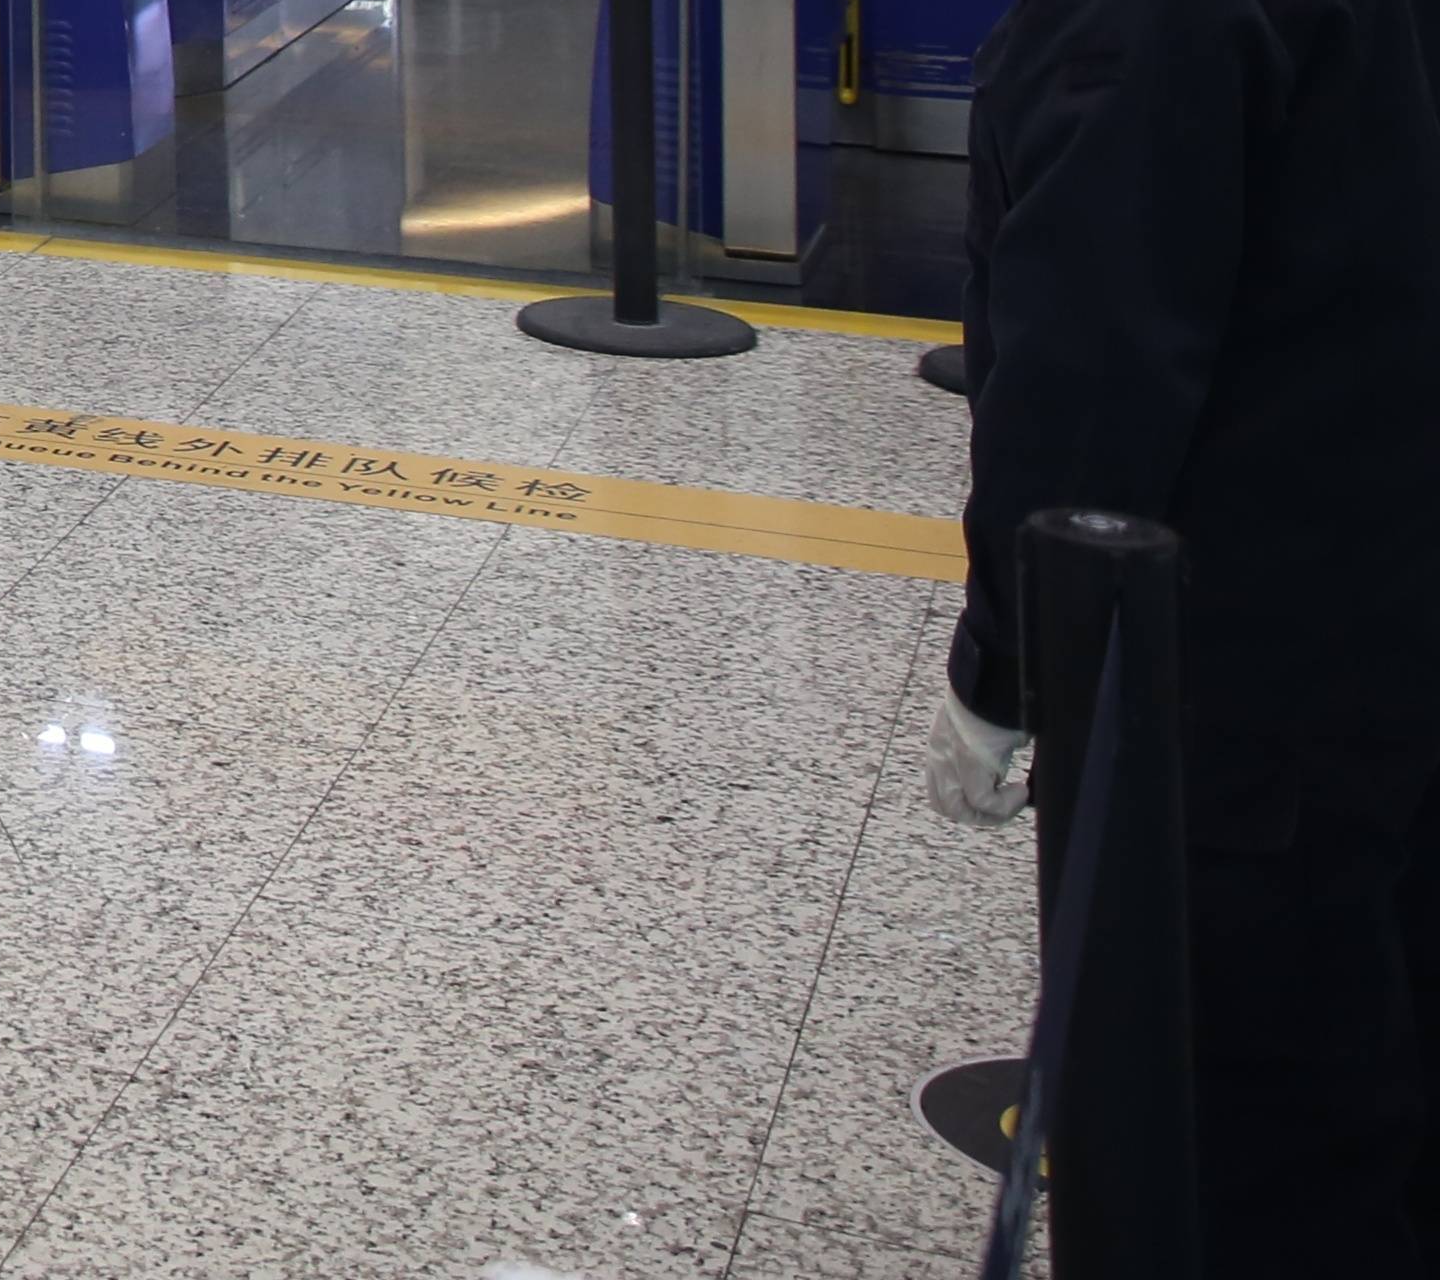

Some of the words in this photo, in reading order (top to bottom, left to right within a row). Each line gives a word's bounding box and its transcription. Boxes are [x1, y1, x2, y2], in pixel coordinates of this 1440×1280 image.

[107, 452, 251, 480] Behind
[261, 472, 323, 489] the
[338, 481, 474, 507] Yellow
[486, 501, 579, 521] Line
